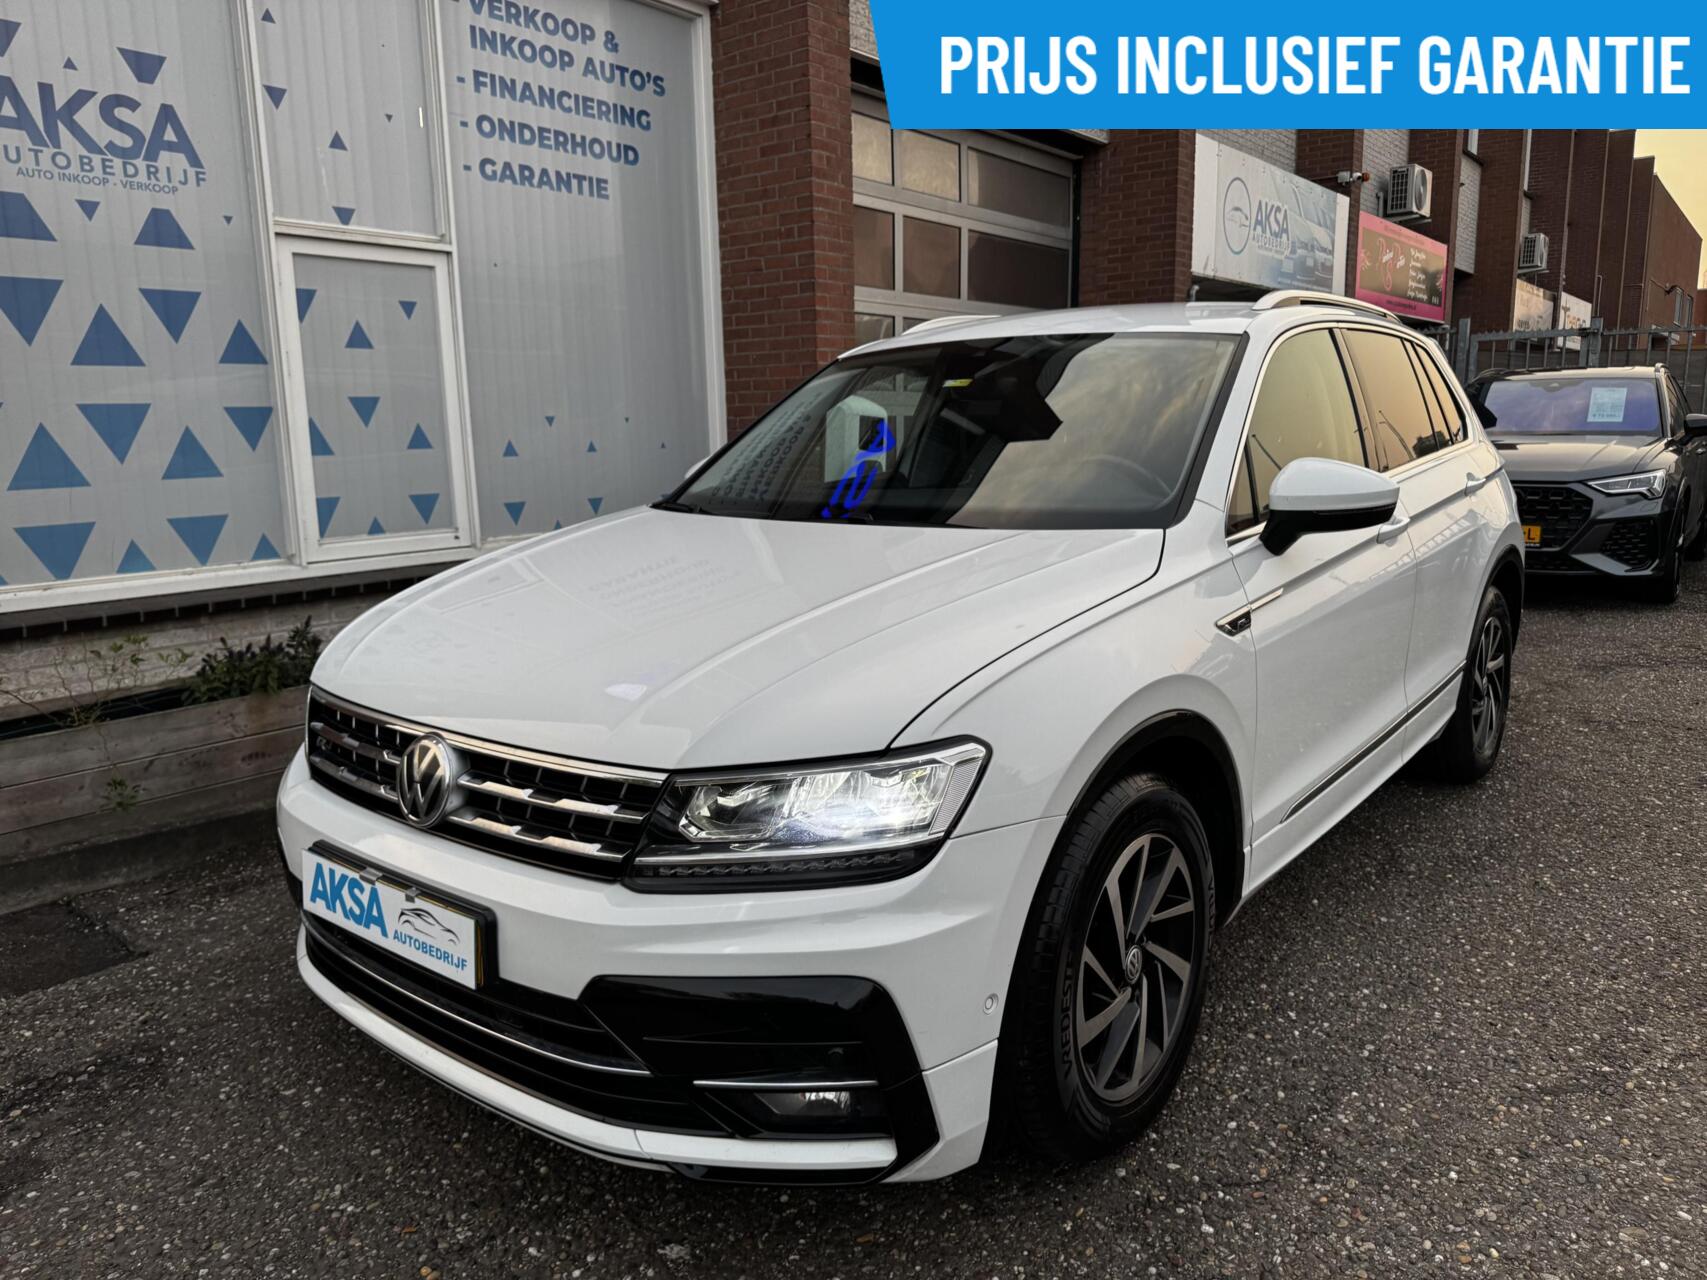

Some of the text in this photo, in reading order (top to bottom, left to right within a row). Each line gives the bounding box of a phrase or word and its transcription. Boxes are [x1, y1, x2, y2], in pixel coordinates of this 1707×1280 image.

[469, 0, 619, 53] VERKOOP &
[469, 25, 666, 97] INKOOP AUTO'S
[0, 74, 205, 170] AKSA
[473, 69, 651, 131] FINANCIERING
[2, 144, 207, 187] UTOBEDRIJF
[476, 114, 639, 166] ONDERHOUD
[16, 166, 54, 180] AUTO
[57, 172, 110, 187] INKOOP
[120, 179, 179, 195] VERKOOP
[478, 158, 610, 200] GARANTIE
[1253, 199, 1290, 240] AKSA
[309, 862, 389, 939] AKSA
[393, 929, 468, 971] AUTOBEDRIJF
